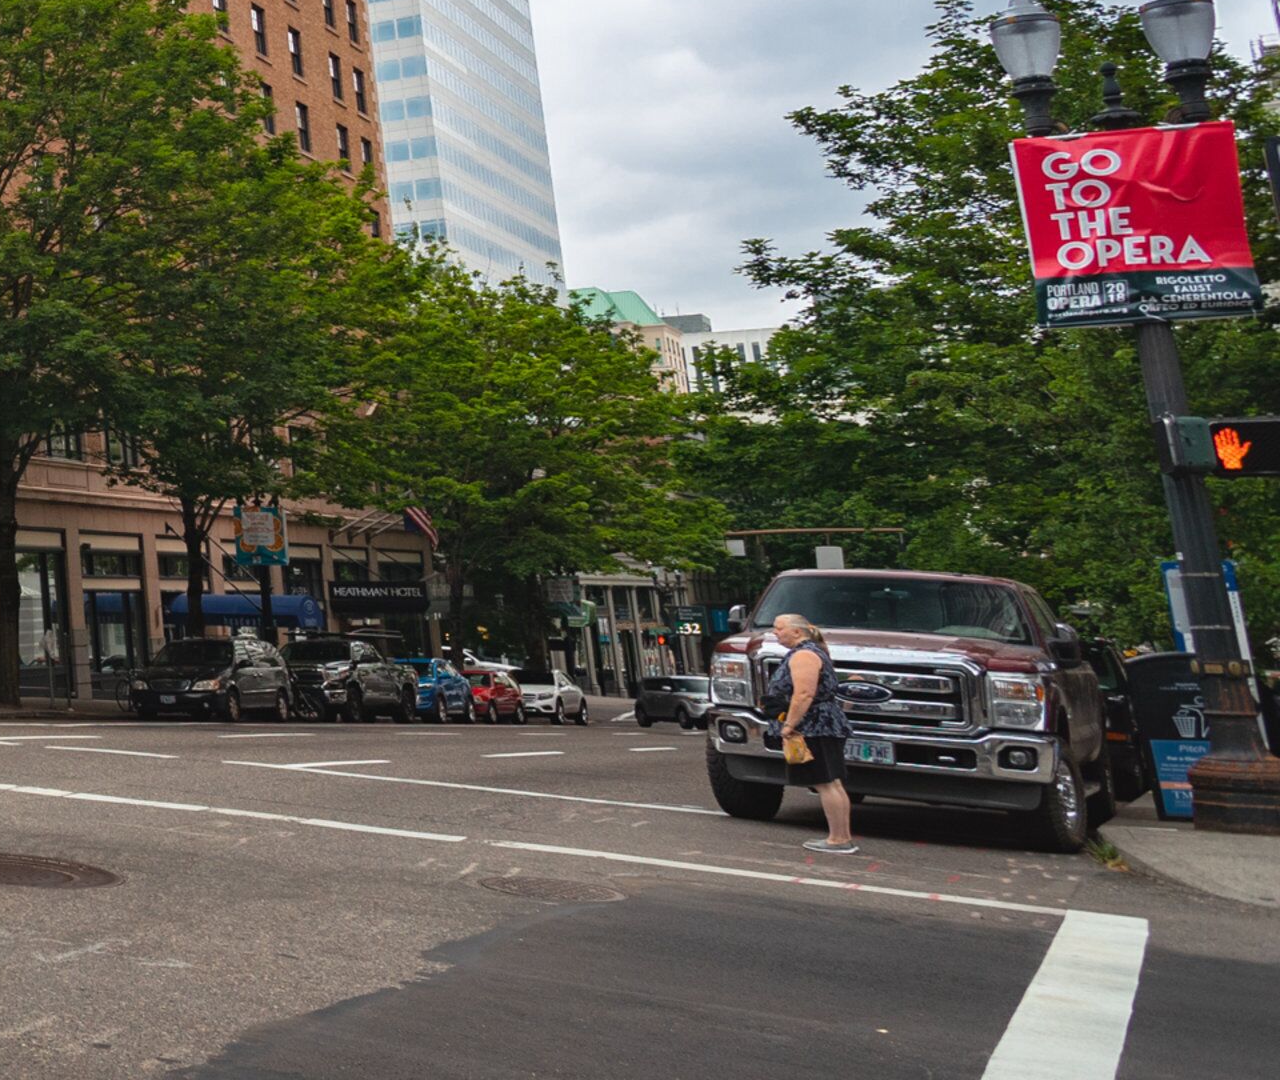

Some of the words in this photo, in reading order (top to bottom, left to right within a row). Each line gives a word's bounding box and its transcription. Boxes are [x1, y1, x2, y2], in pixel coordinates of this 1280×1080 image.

[1041, 148, 1122, 180] GO
[1045, 179, 1111, 210] TO
[1050, 206, 1133, 240] THE
[1056, 235, 1212, 270] OPERA
[1155, 274, 1226, 285] RIGOLETTO
[1047, 282, 1099, 297] PORTLAND
[1106, 282, 1125, 294] 20
[1173, 284, 1212, 293] FAUST
[1047, 294, 1102, 310] OPERA
[1107, 293, 1125, 303] 18
[1141, 295, 1158, 303] LA
[1161, 291, 1251, 303] CENERENTOLA
[333, 587, 389, 597] HEATHMAN
[391, 587, 424, 598] HOTEL
[1179, 744, 1206, 753] Pitch
